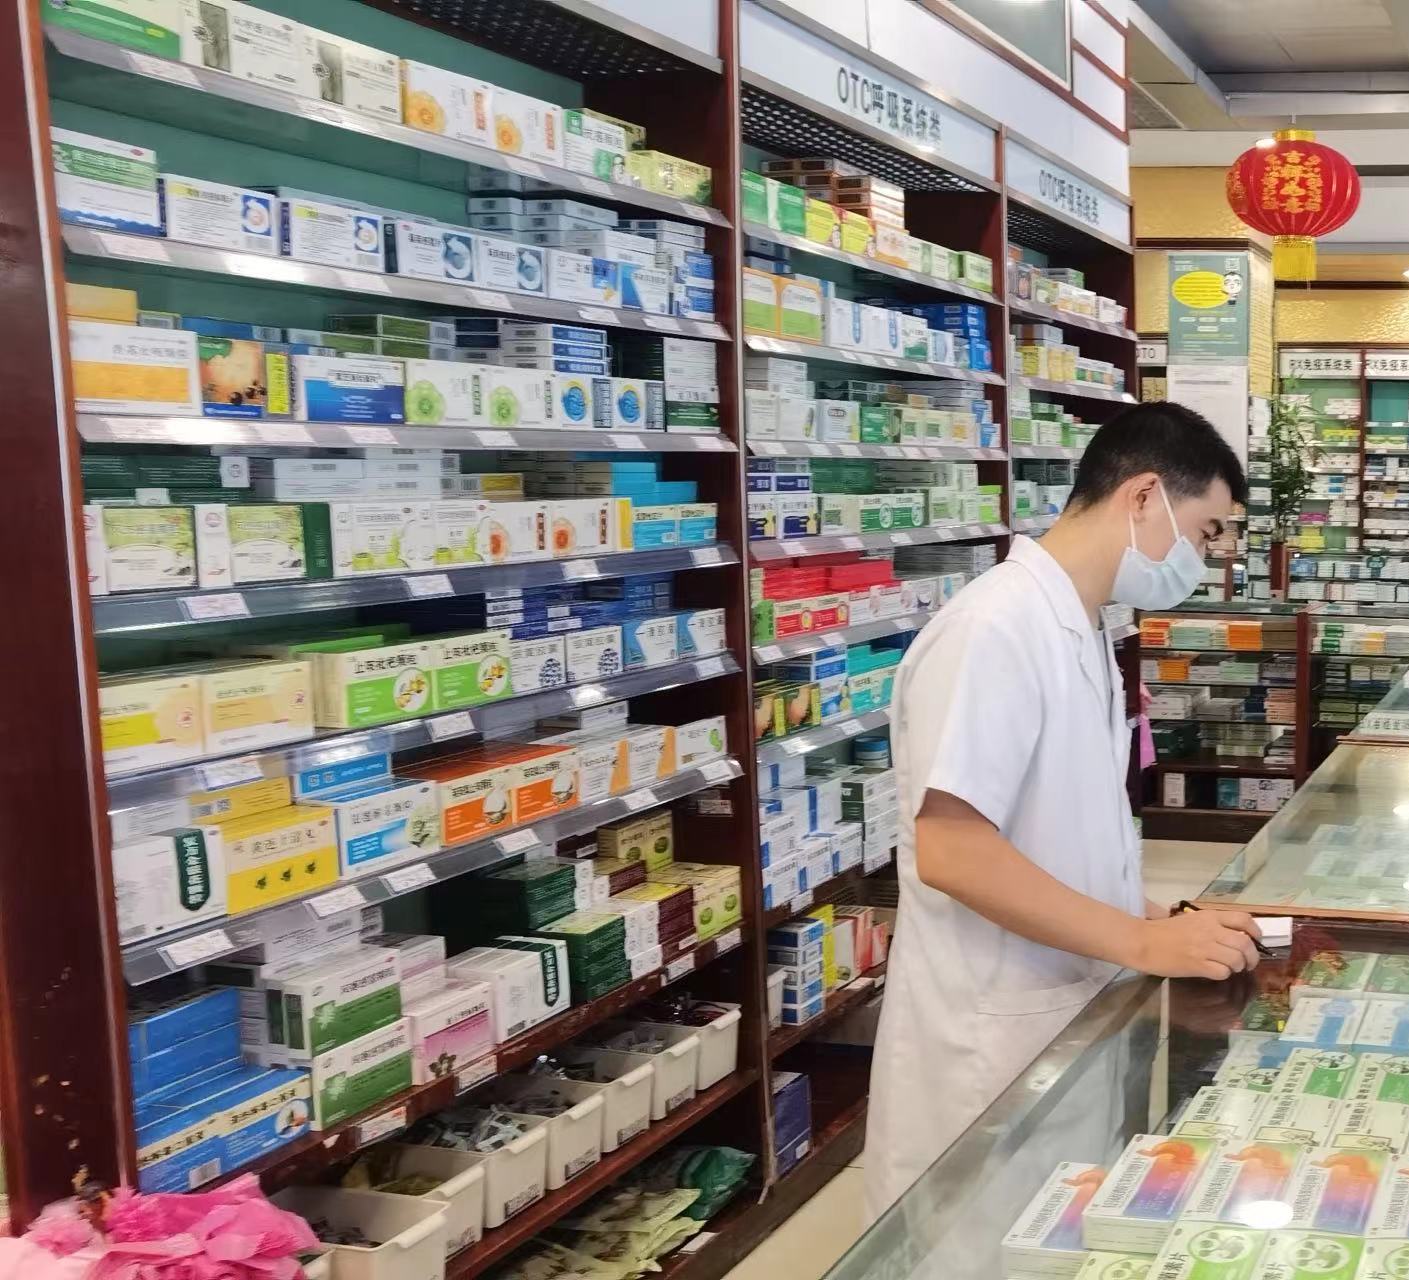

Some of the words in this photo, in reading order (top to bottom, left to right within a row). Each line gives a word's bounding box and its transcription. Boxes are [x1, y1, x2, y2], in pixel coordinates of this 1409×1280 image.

[838, 66, 941, 141] OTC呼吸系统类
[1039, 169, 1099, 225] OTC呼吸系统类
